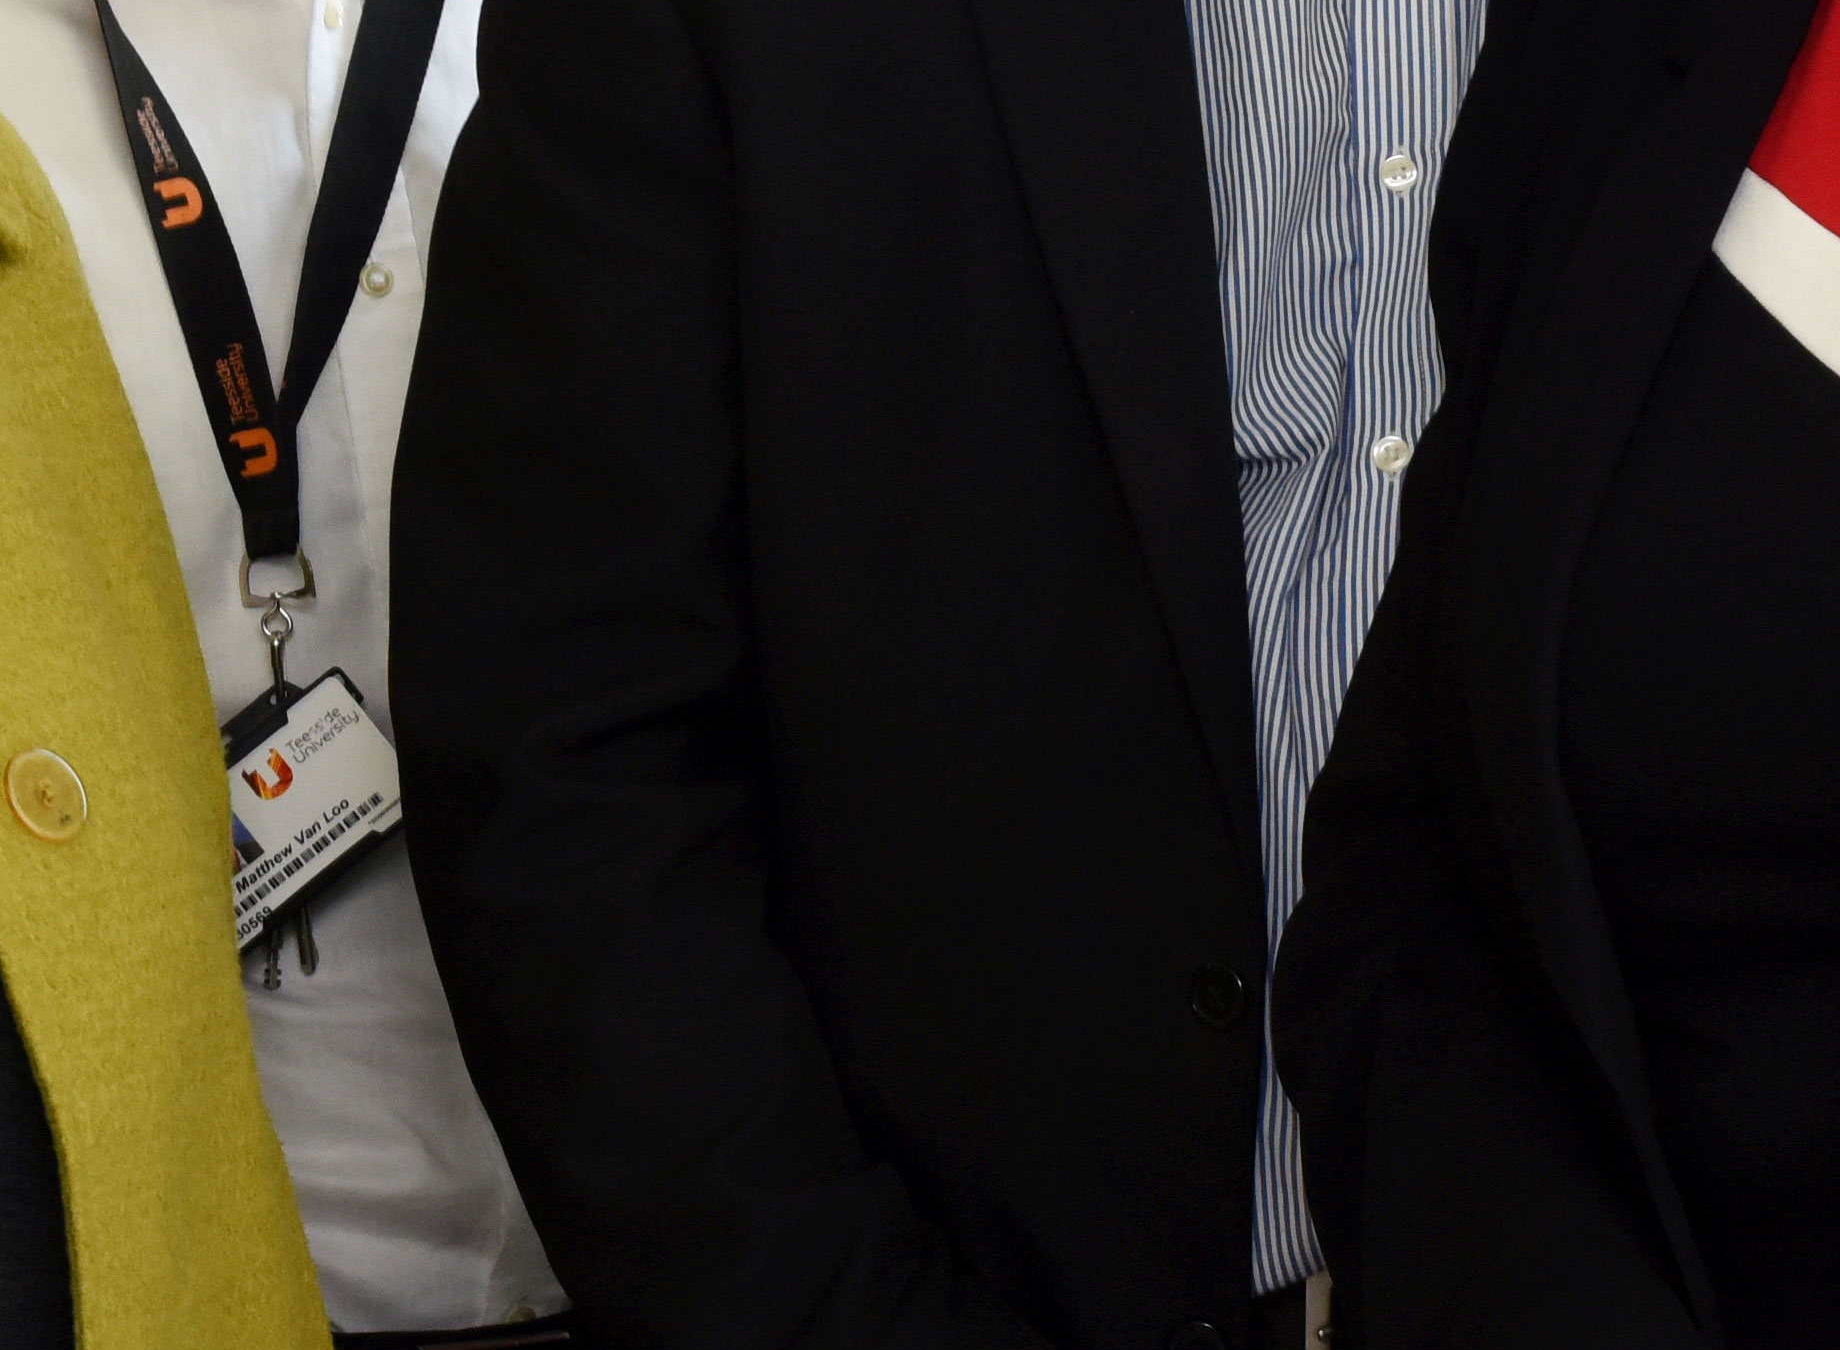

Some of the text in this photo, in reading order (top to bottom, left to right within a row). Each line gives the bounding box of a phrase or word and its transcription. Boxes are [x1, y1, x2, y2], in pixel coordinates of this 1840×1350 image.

[292, 709, 360, 765] University
[235, 842, 293, 895] Matthew
[294, 819, 322, 846] Van
[322, 798, 350, 824] Loo
